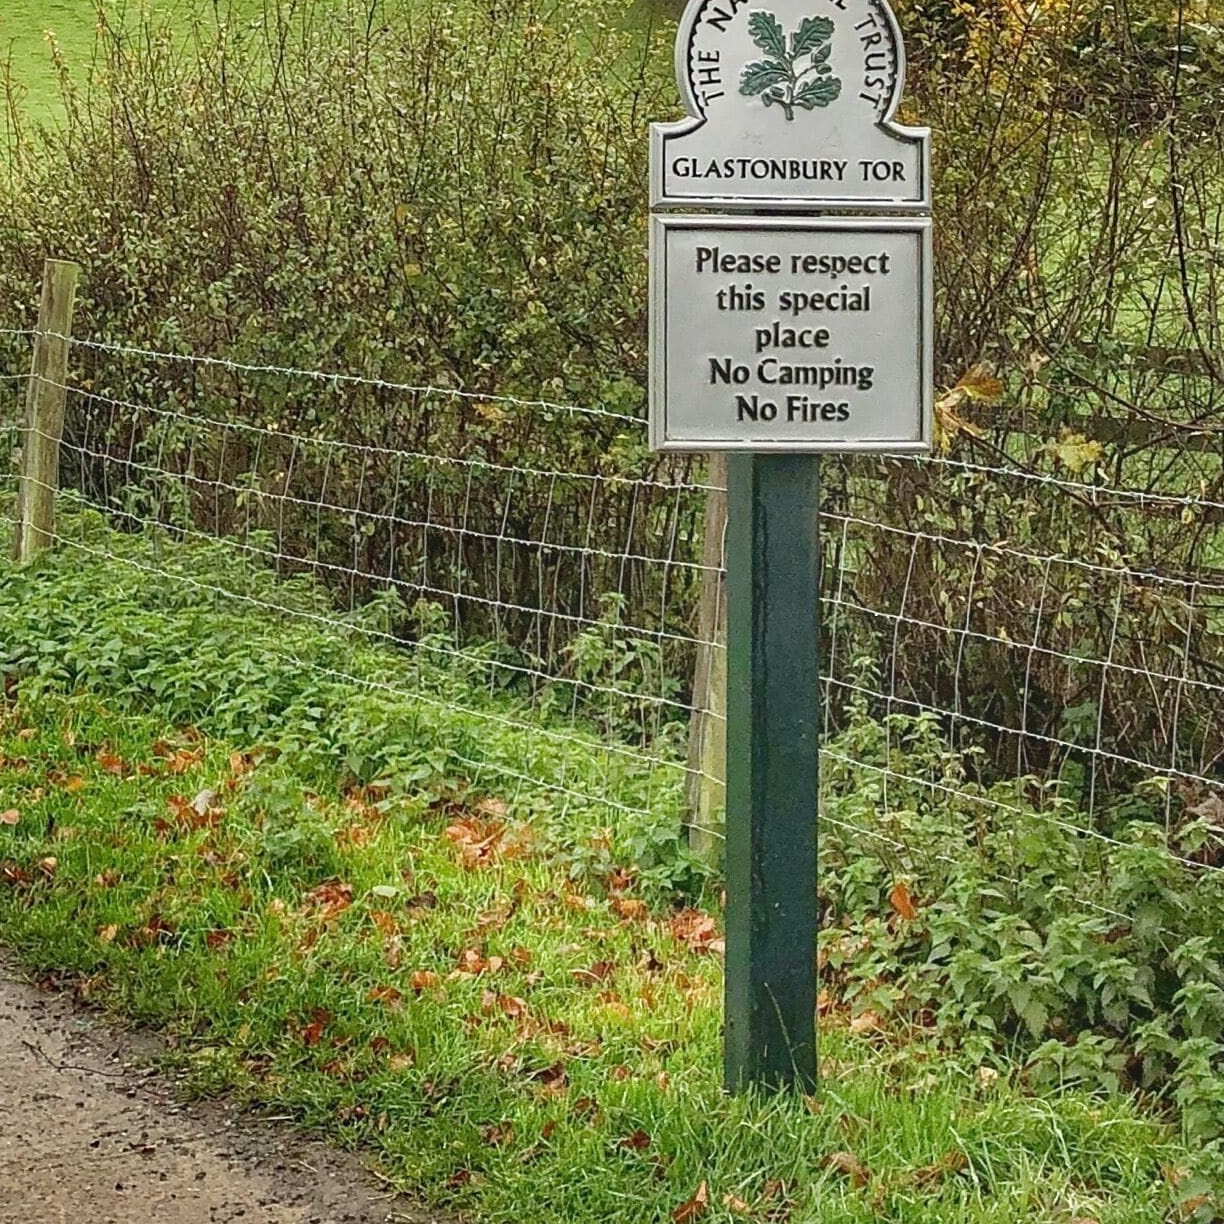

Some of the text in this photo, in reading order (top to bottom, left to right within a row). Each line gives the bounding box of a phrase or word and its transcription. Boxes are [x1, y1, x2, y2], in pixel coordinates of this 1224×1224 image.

[699, 49, 724, 107] THE
[853, 13, 886, 108] TRUST
[672, 156, 907, 182] GLASTONBURY TOR
[695, 246, 891, 280] Please respect
[716, 284, 870, 316] this special
[754, 321, 830, 353] place
[708, 357, 874, 390] No Camping
[735, 395, 851, 423] No Fires
